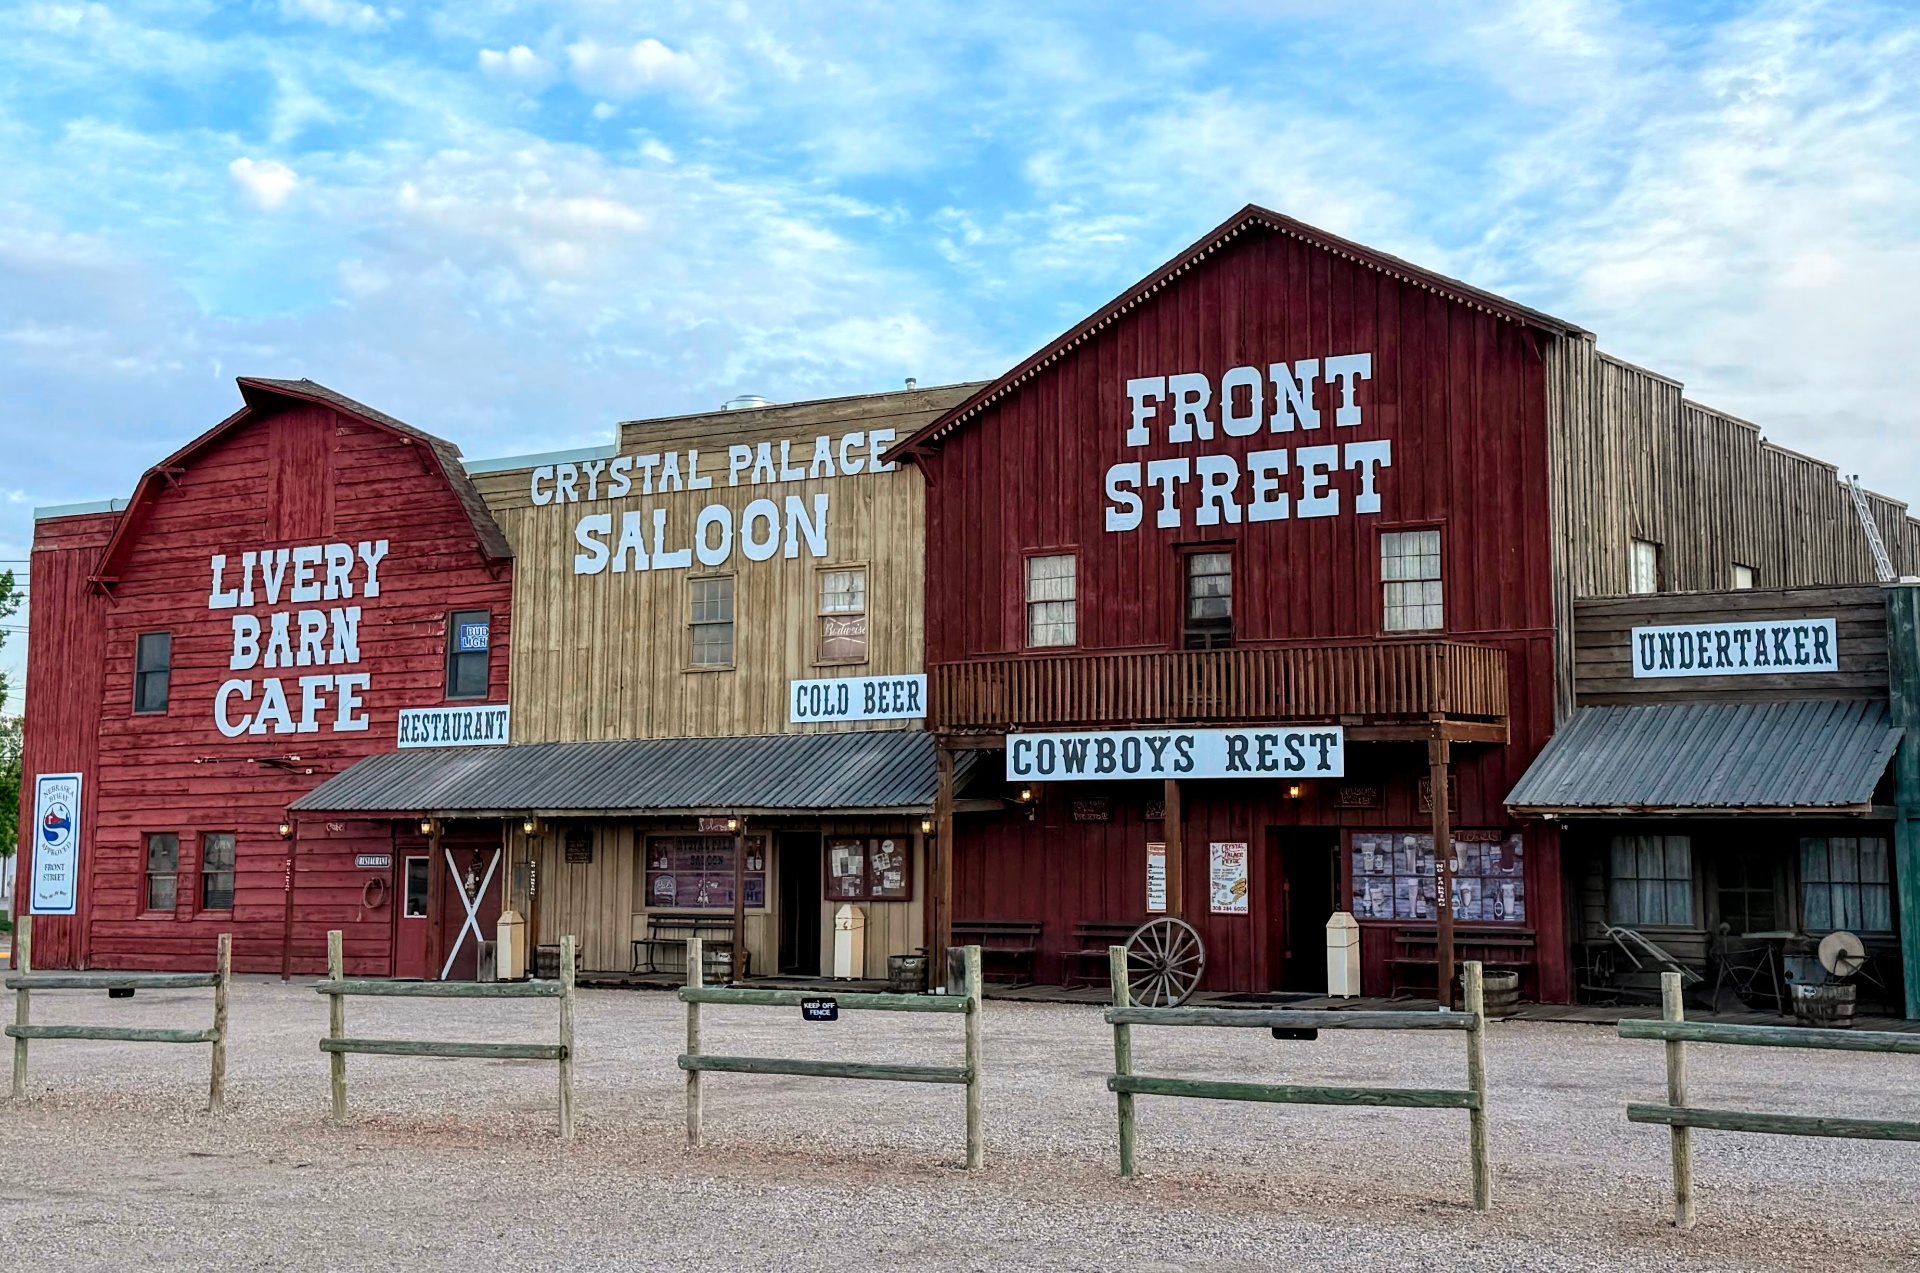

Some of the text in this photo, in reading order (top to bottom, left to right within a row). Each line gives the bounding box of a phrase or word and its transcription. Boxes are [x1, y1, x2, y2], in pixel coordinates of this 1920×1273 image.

[1126, 352, 1373, 447] FRONT
[531, 428, 897, 506] CRYSTAL PALACE
[1104, 439, 1392, 532] STREET
[574, 493, 829, 575] SALOON
[208, 539, 389, 610] LIVERY
[229, 606, 361, 671] BARN
[462, 636, 489, 648] LIGH
[466, 626, 490, 636] BUD
[824, 622, 866, 637] Budweise
[1638, 624, 1832, 671] UNDERTAKER
[214, 673, 371, 738] CAFE
[796, 679, 922, 717] COLD BEER
[399, 710, 507, 743] RESTAURANT
[1012, 732, 1338, 776] COWBOYS REST
[43, 784, 74, 798] NEBRASKA
[49, 792, 70, 802] BYWAY
[41, 841, 72, 856] APPROVED
[358, 856, 389, 866] RESTAURANT
[43, 873, 66, 882] STREET
[44, 863, 65, 872] FRONT
